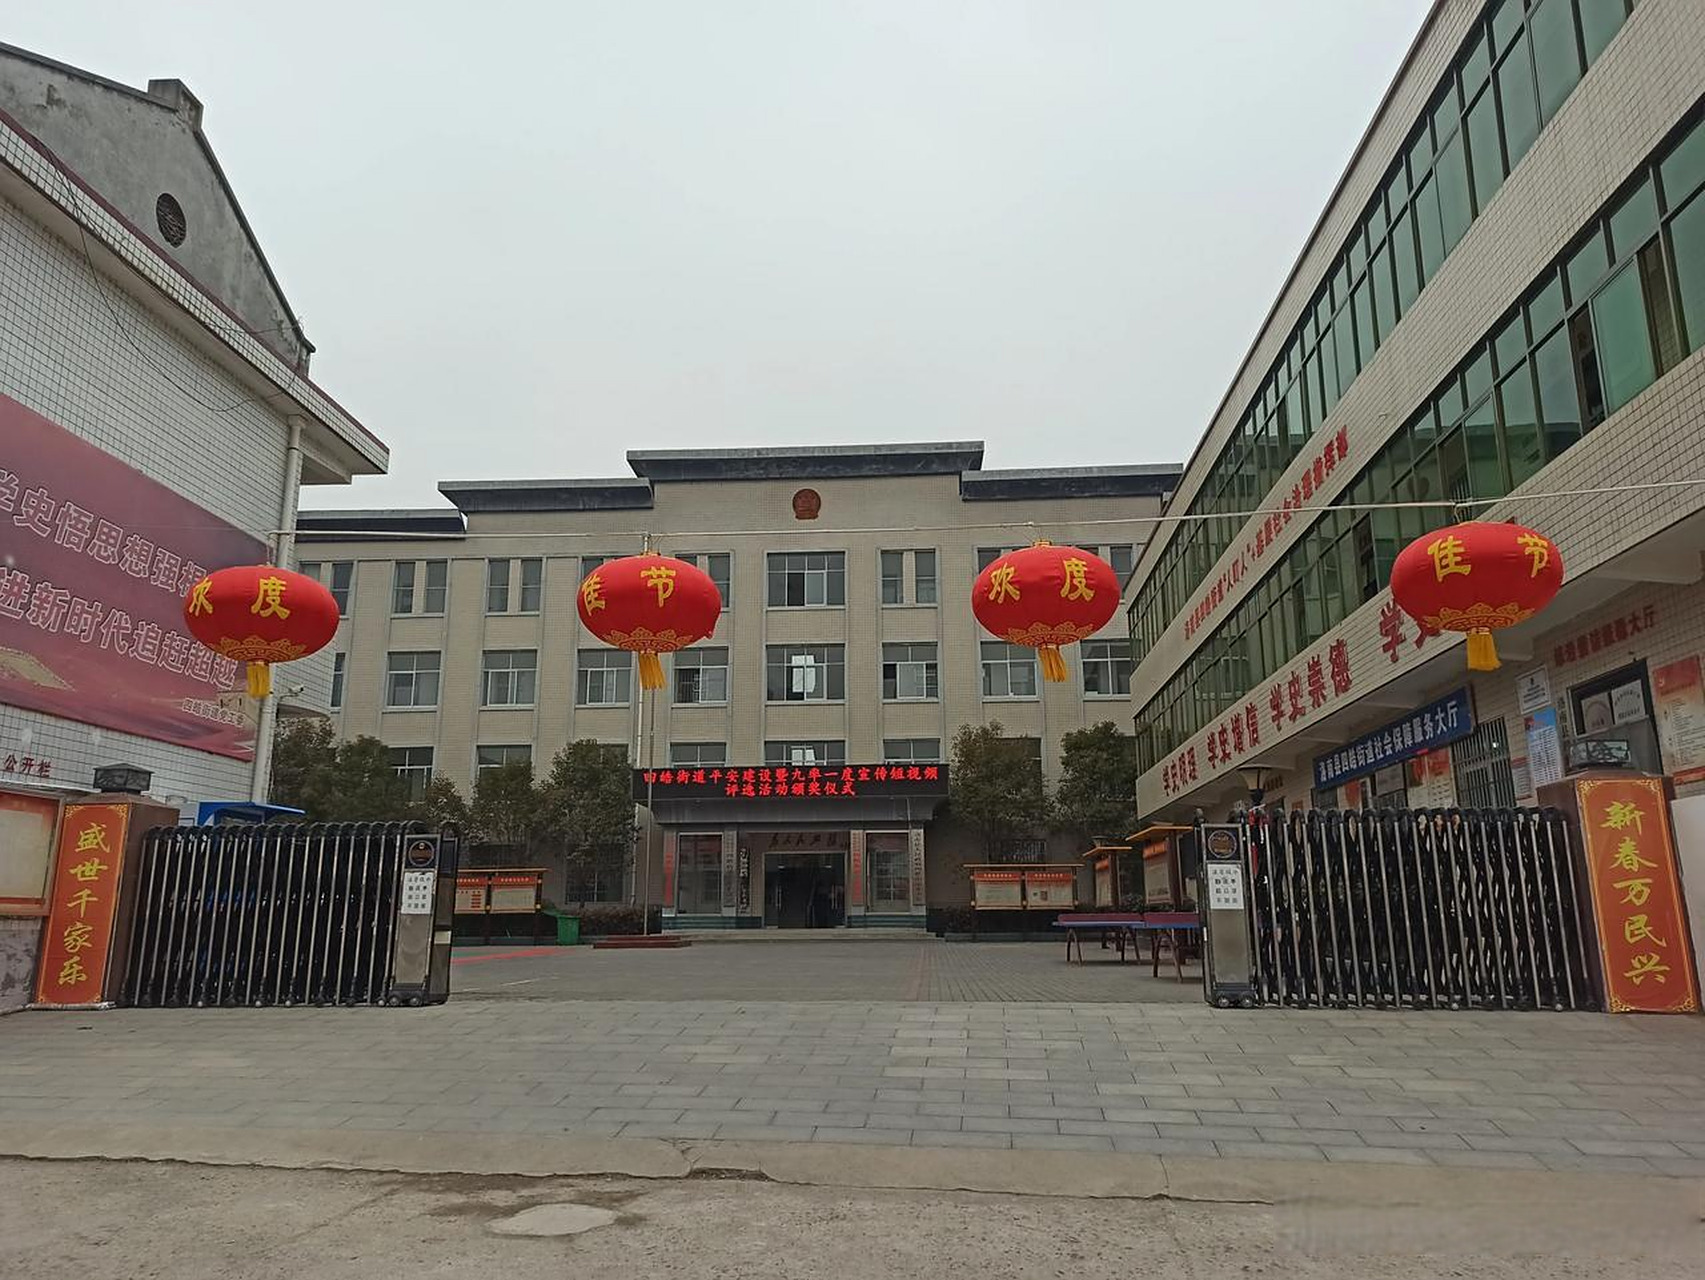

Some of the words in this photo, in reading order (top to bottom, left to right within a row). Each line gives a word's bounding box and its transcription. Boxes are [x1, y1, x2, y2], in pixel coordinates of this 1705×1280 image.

[989, 558, 1095, 604] 欢度
[1427, 533, 1549, 582] 佳节
[189, 576, 291, 619] 欢度
[582, 566, 676, 616] 佳节
[1207, 702, 1260, 769] 学史增信
[1269, 638, 1352, 732] 学史崇德
[3, 754, 51, 778] 公开栏
[725, 781, 856, 797] 评选活动颁奖仪式
[58, 822, 111, 985] 盛世千家乐
[1599, 801, 1671, 986] 新春万民兴
